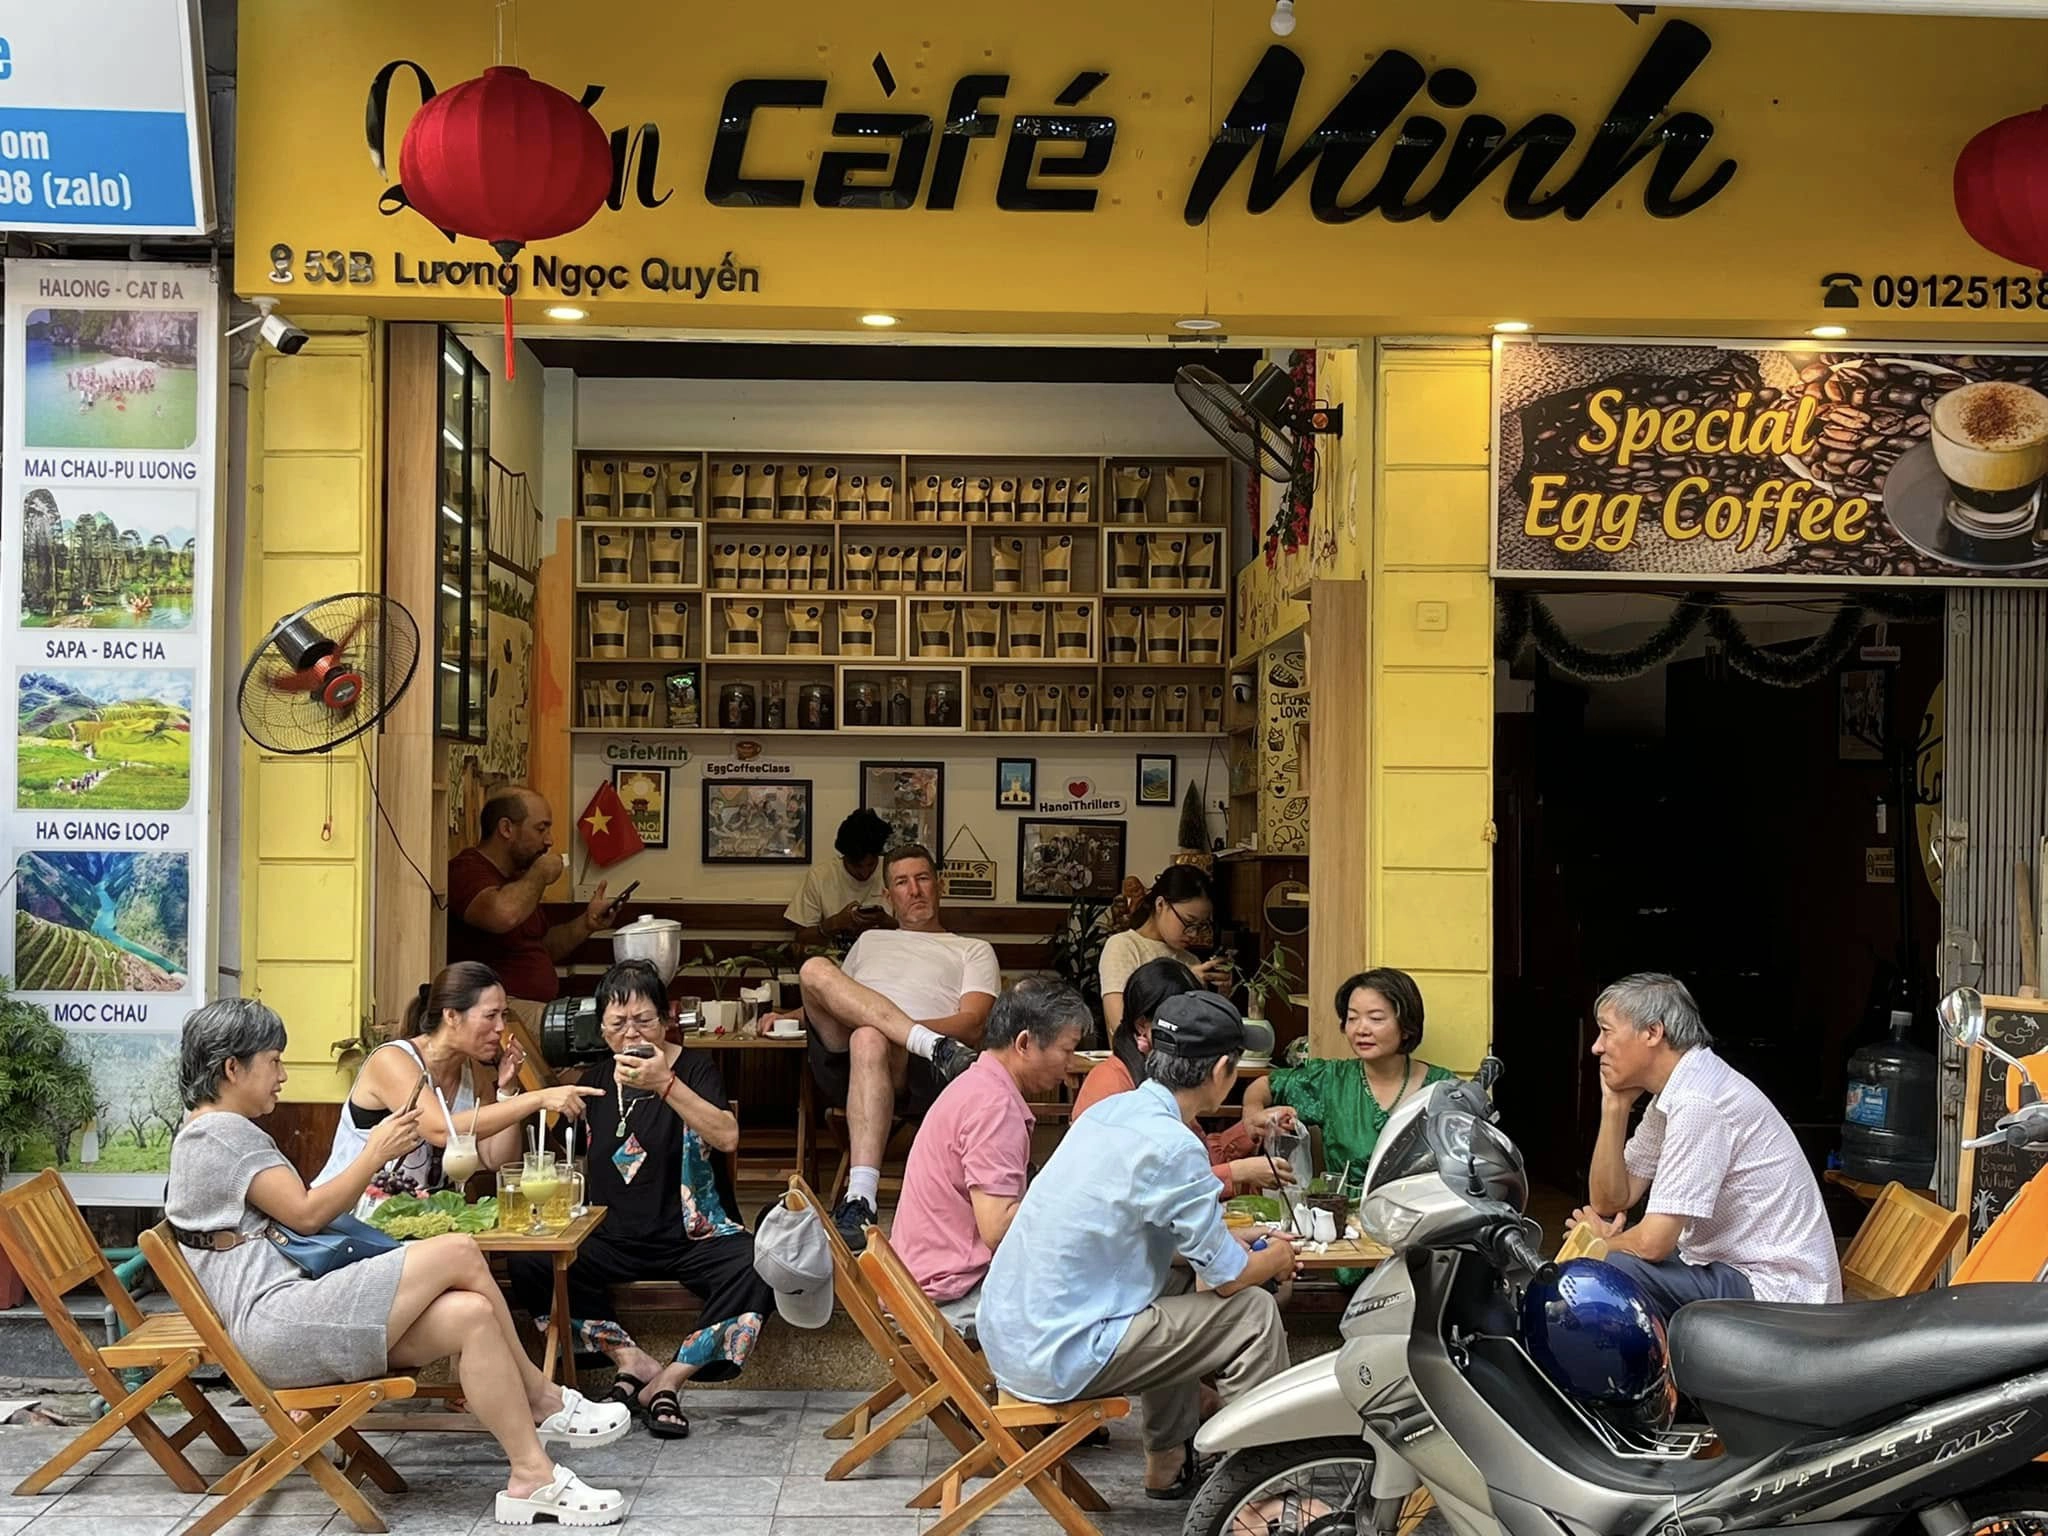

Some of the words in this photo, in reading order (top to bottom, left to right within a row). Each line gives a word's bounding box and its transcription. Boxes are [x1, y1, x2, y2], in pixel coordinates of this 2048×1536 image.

[704, 51, 1117, 211] Càfé
[1184, 19, 1737, 226] Minh
[42, 171, 132, 211] (zalo)
[304, 249, 375, 284] 53B
[395, 252, 519, 296] Lương
[533, 255, 629, 297] Ngọc
[641, 252, 760, 299] Quyến
[39, 278, 110, 298] HALONG
[126, 280, 158, 299] CAT
[162, 282, 184, 299] BA
[1577, 388, 1819, 467] Special
[24, 459, 56, 478] MAI
[60, 460, 134, 479] CHAU-PU
[139, 461, 197, 480] LUONG
[1523, 474, 1644, 552] Egg
[1661, 474, 1870, 552] Coffee
[46, 640, 88, 659] SAPA
[103, 641, 137, 660] BAC
[142, 642, 165, 660] HA
[706, 763, 791, 776] EggCoffeeClass
[1039, 797, 1121, 813] HanoiThrillers
[36, 821, 60, 840] HA
[63, 822, 120, 841] GIANG
[125, 823, 170, 842] LOOP
[54, 1003, 97, 1022] MOC
[101, 1004, 148, 1022] CHAU
[1933, 1408, 2030, 1464] MX
